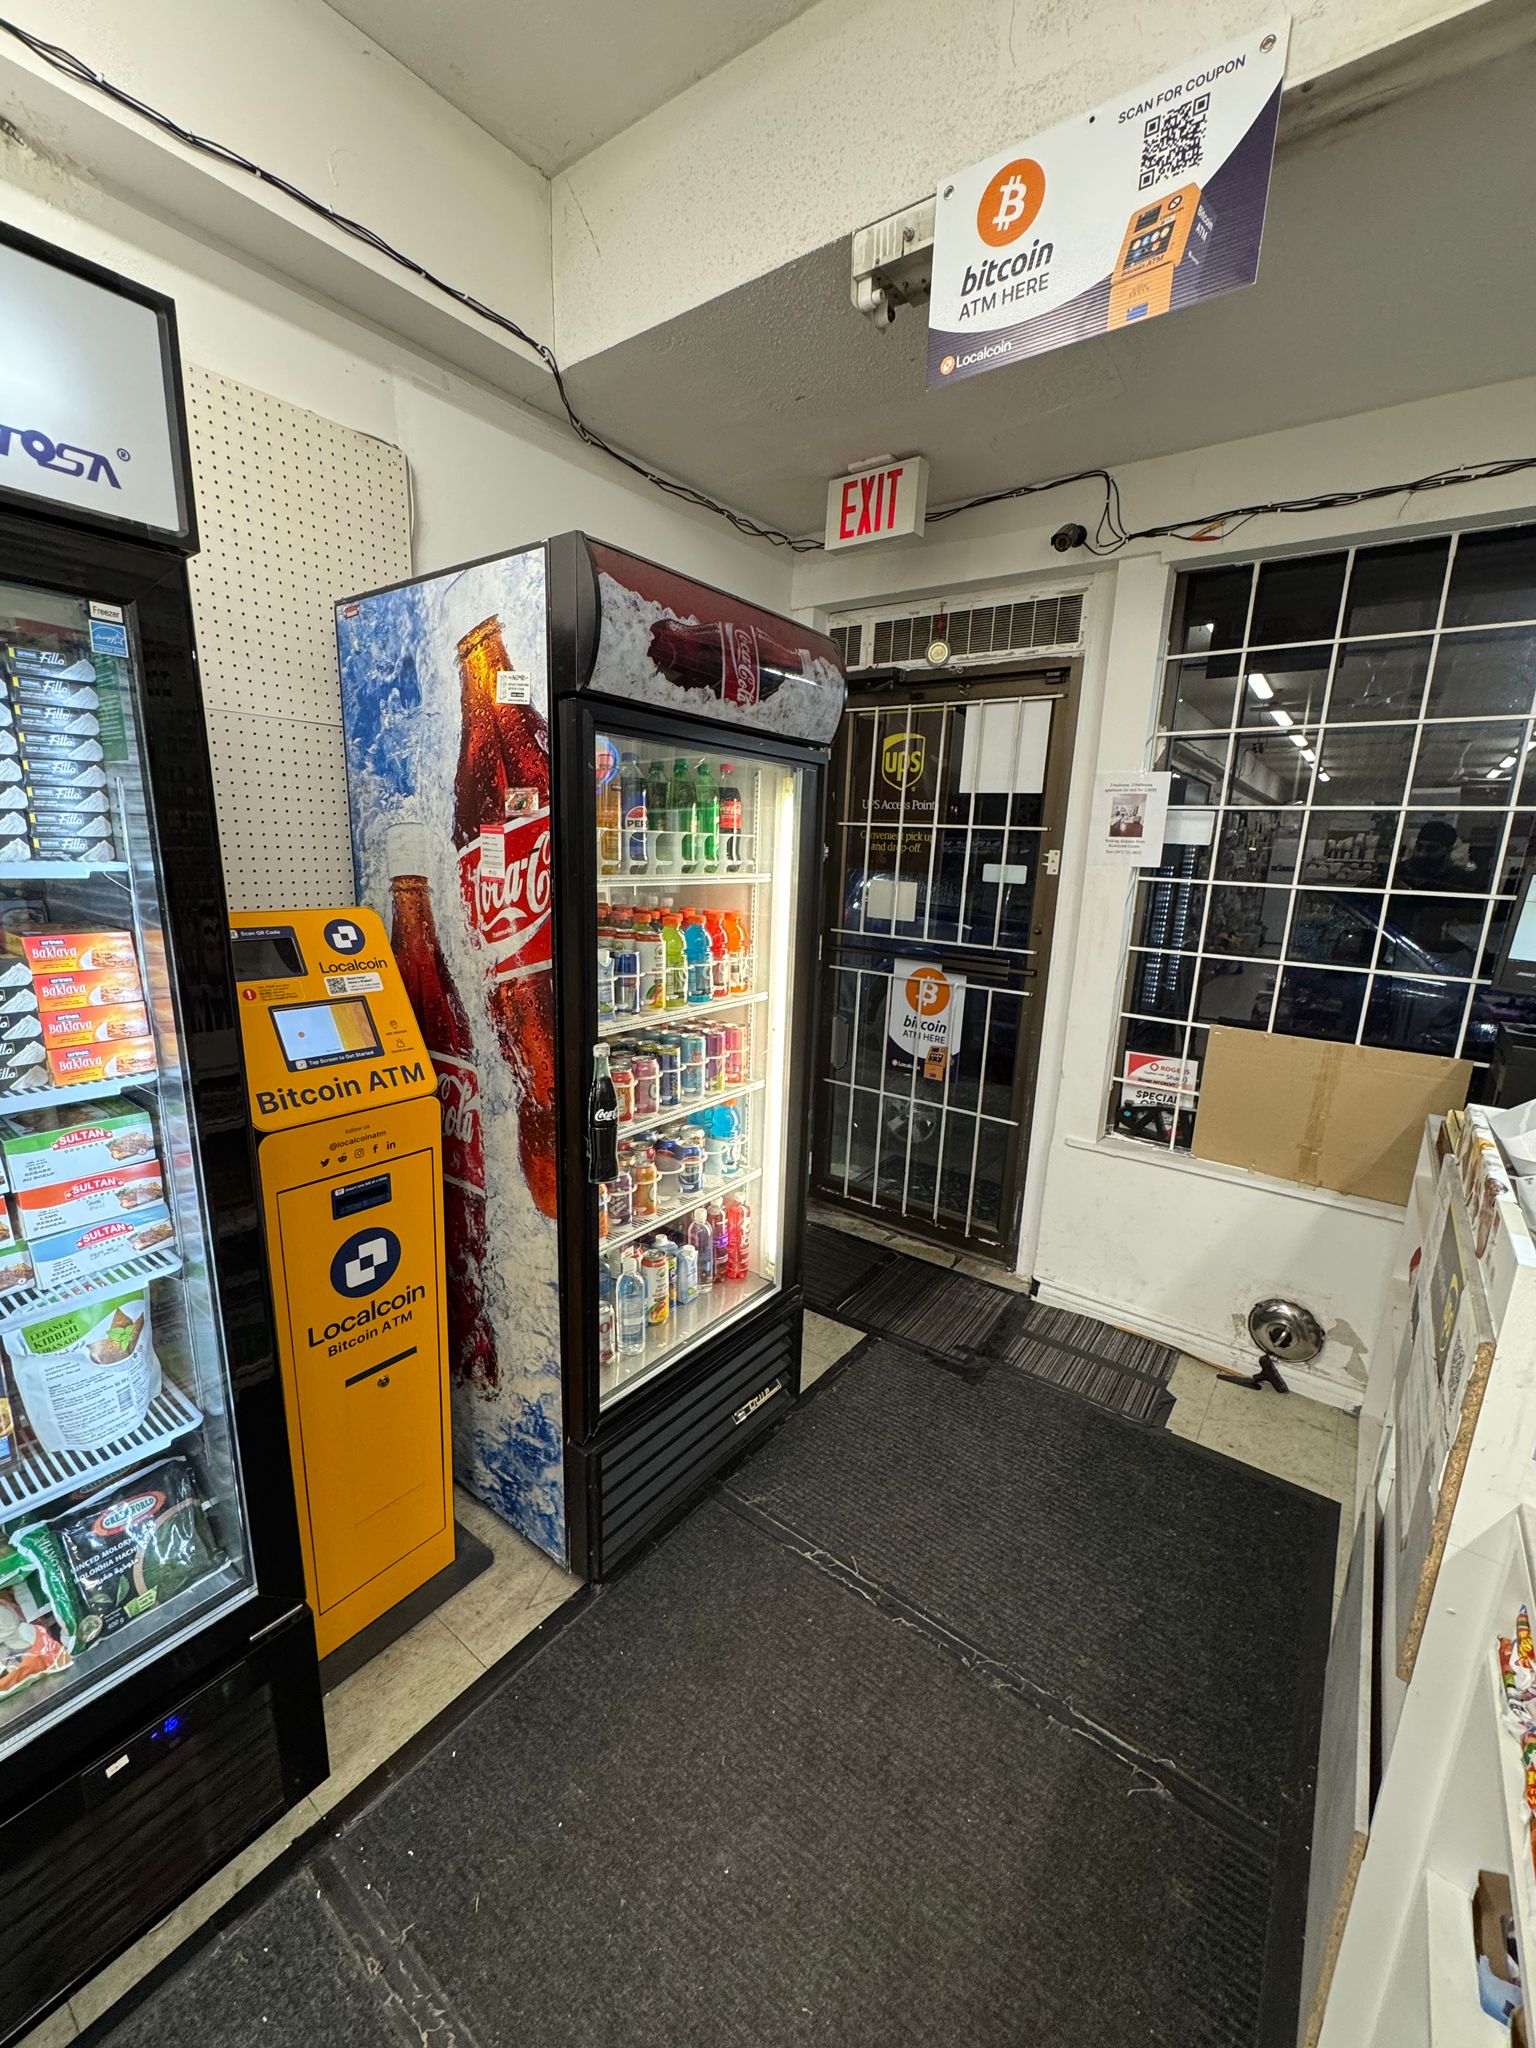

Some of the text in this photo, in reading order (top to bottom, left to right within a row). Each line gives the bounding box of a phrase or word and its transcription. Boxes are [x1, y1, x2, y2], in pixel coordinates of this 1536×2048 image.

[1118, 55, 1247, 124] SCAN FOR COUPON
[960, 239, 1054, 297] bitcoin
[959, 272, 1050, 321] ATM HERE
[956, 340, 1012, 368] Localcoin
[839, 467, 904, 540] EXIT
[92, 605, 120, 618] Freezer
[885, 750, 922, 782] ups
[870, 842, 886, 851] and
[905, 832, 924, 843] pick
[31, 946, 77, 959] Baklava
[318, 957, 388, 974] Localcoin
[42, 984, 86, 997] Baklava
[49, 1020, 93, 1034] Baklava
[923, 1032, 946, 1044] HERE
[59, 1056, 102, 1072] Baklava
[309, 1059, 320, 1067] Tap
[319, 1056, 338, 1064] Screen
[355, 1049, 375, 1058] Started
[256, 1062, 426, 1115] Bitcoin ATM
[59, 1129, 105, 1145] SULTAN
[345, 1126, 362, 1135] follow
[329, 1130, 387, 1151] @localcoinatm
[72, 1177, 116, 1195] SULTAN
[82, 1223, 126, 1242] SULTAN
[307, 1284, 427, 1348] Localcoin
[30, 1318, 74, 1341] LEBANESE
[33, 1325, 79, 1349] KIBBEH
[327, 1310, 413, 1357] Bitcoin ATM
